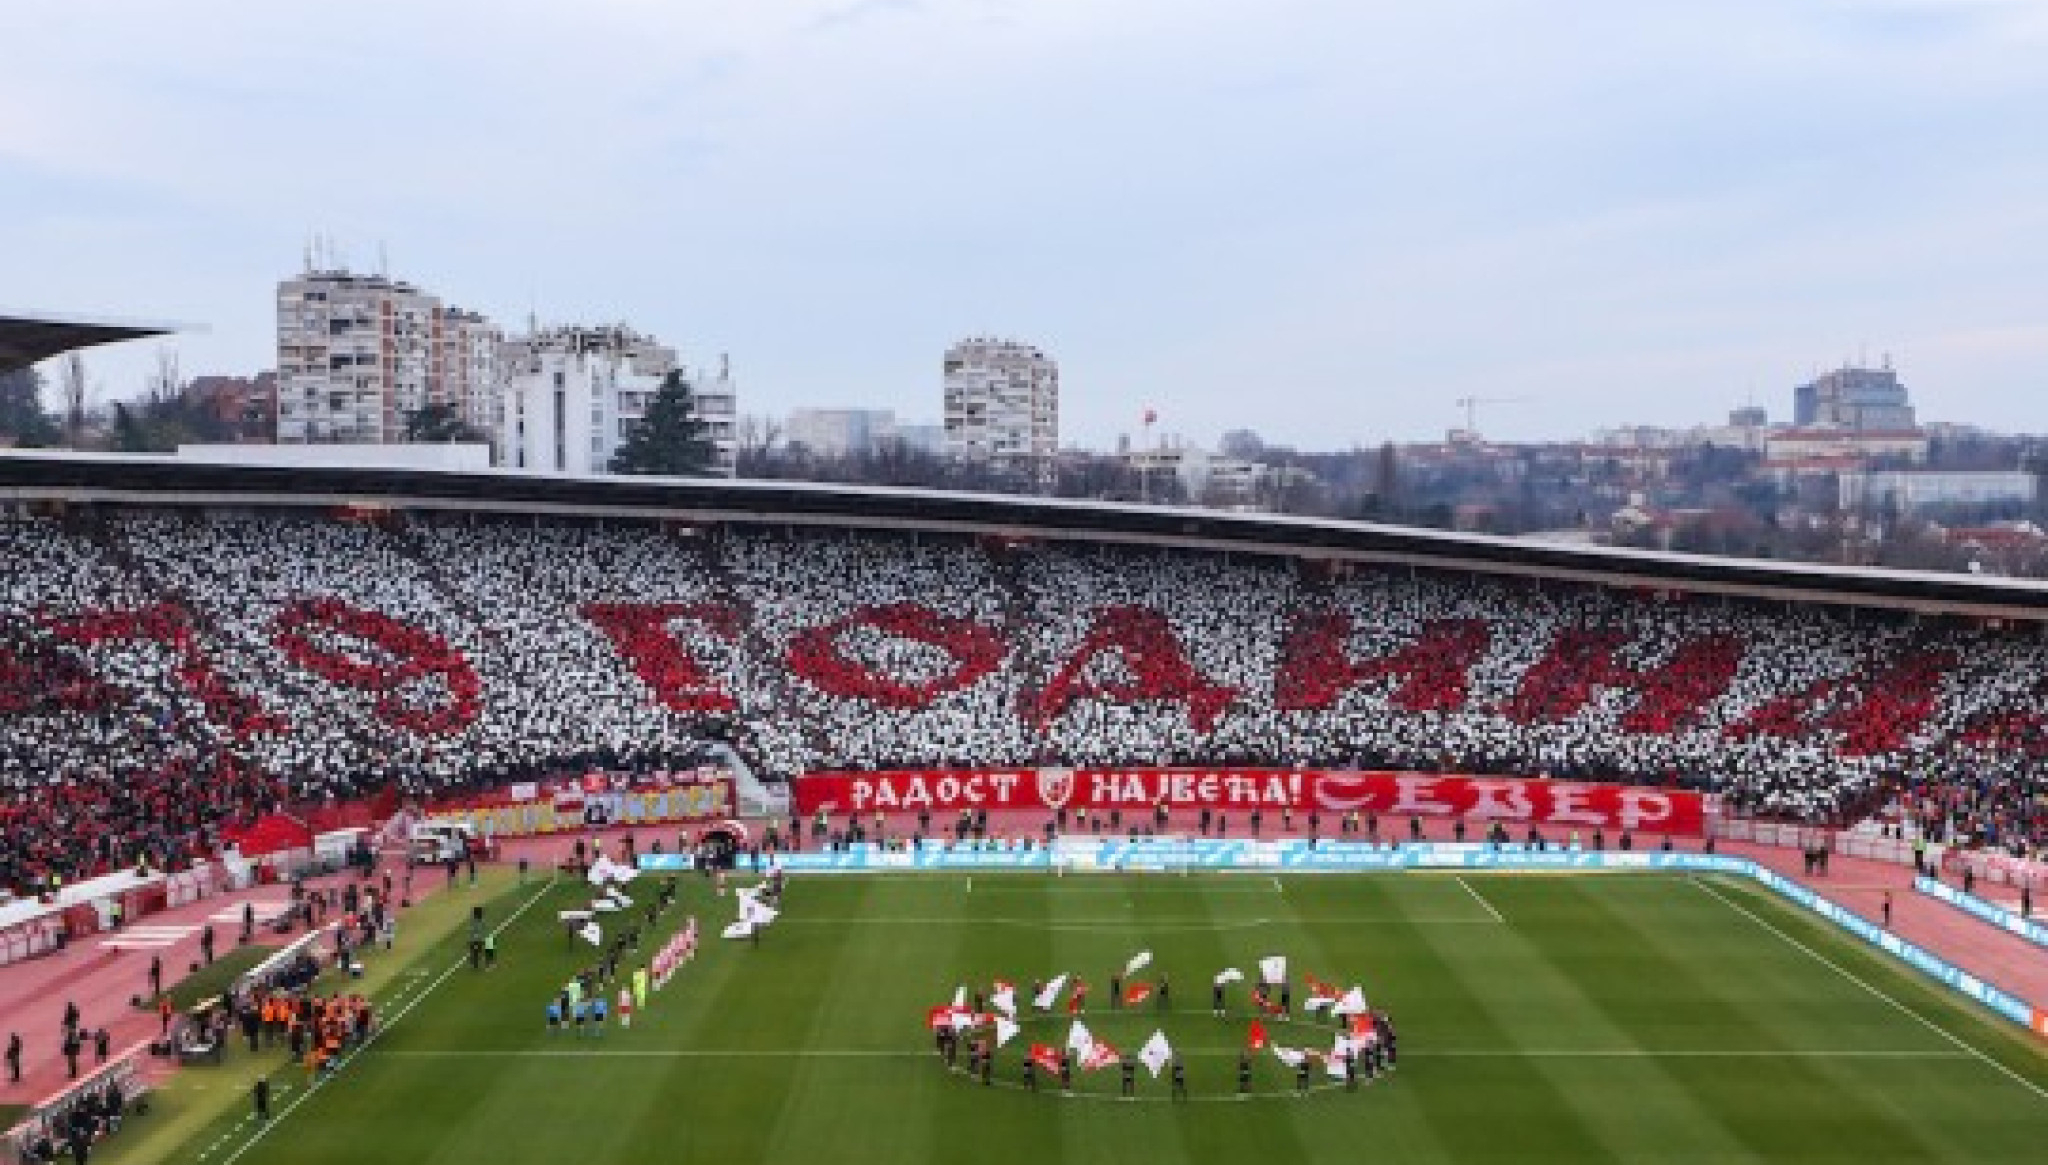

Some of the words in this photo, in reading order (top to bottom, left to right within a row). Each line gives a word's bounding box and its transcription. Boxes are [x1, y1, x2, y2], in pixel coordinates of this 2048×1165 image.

[582, 601, 1958, 756] ГОДИНА
[852, 774, 1019, 809] РАДОСТ
[1092, 773, 1301, 808] НАЈВЕЋА!
[1313, 773, 1673, 828] СЕВЕР
